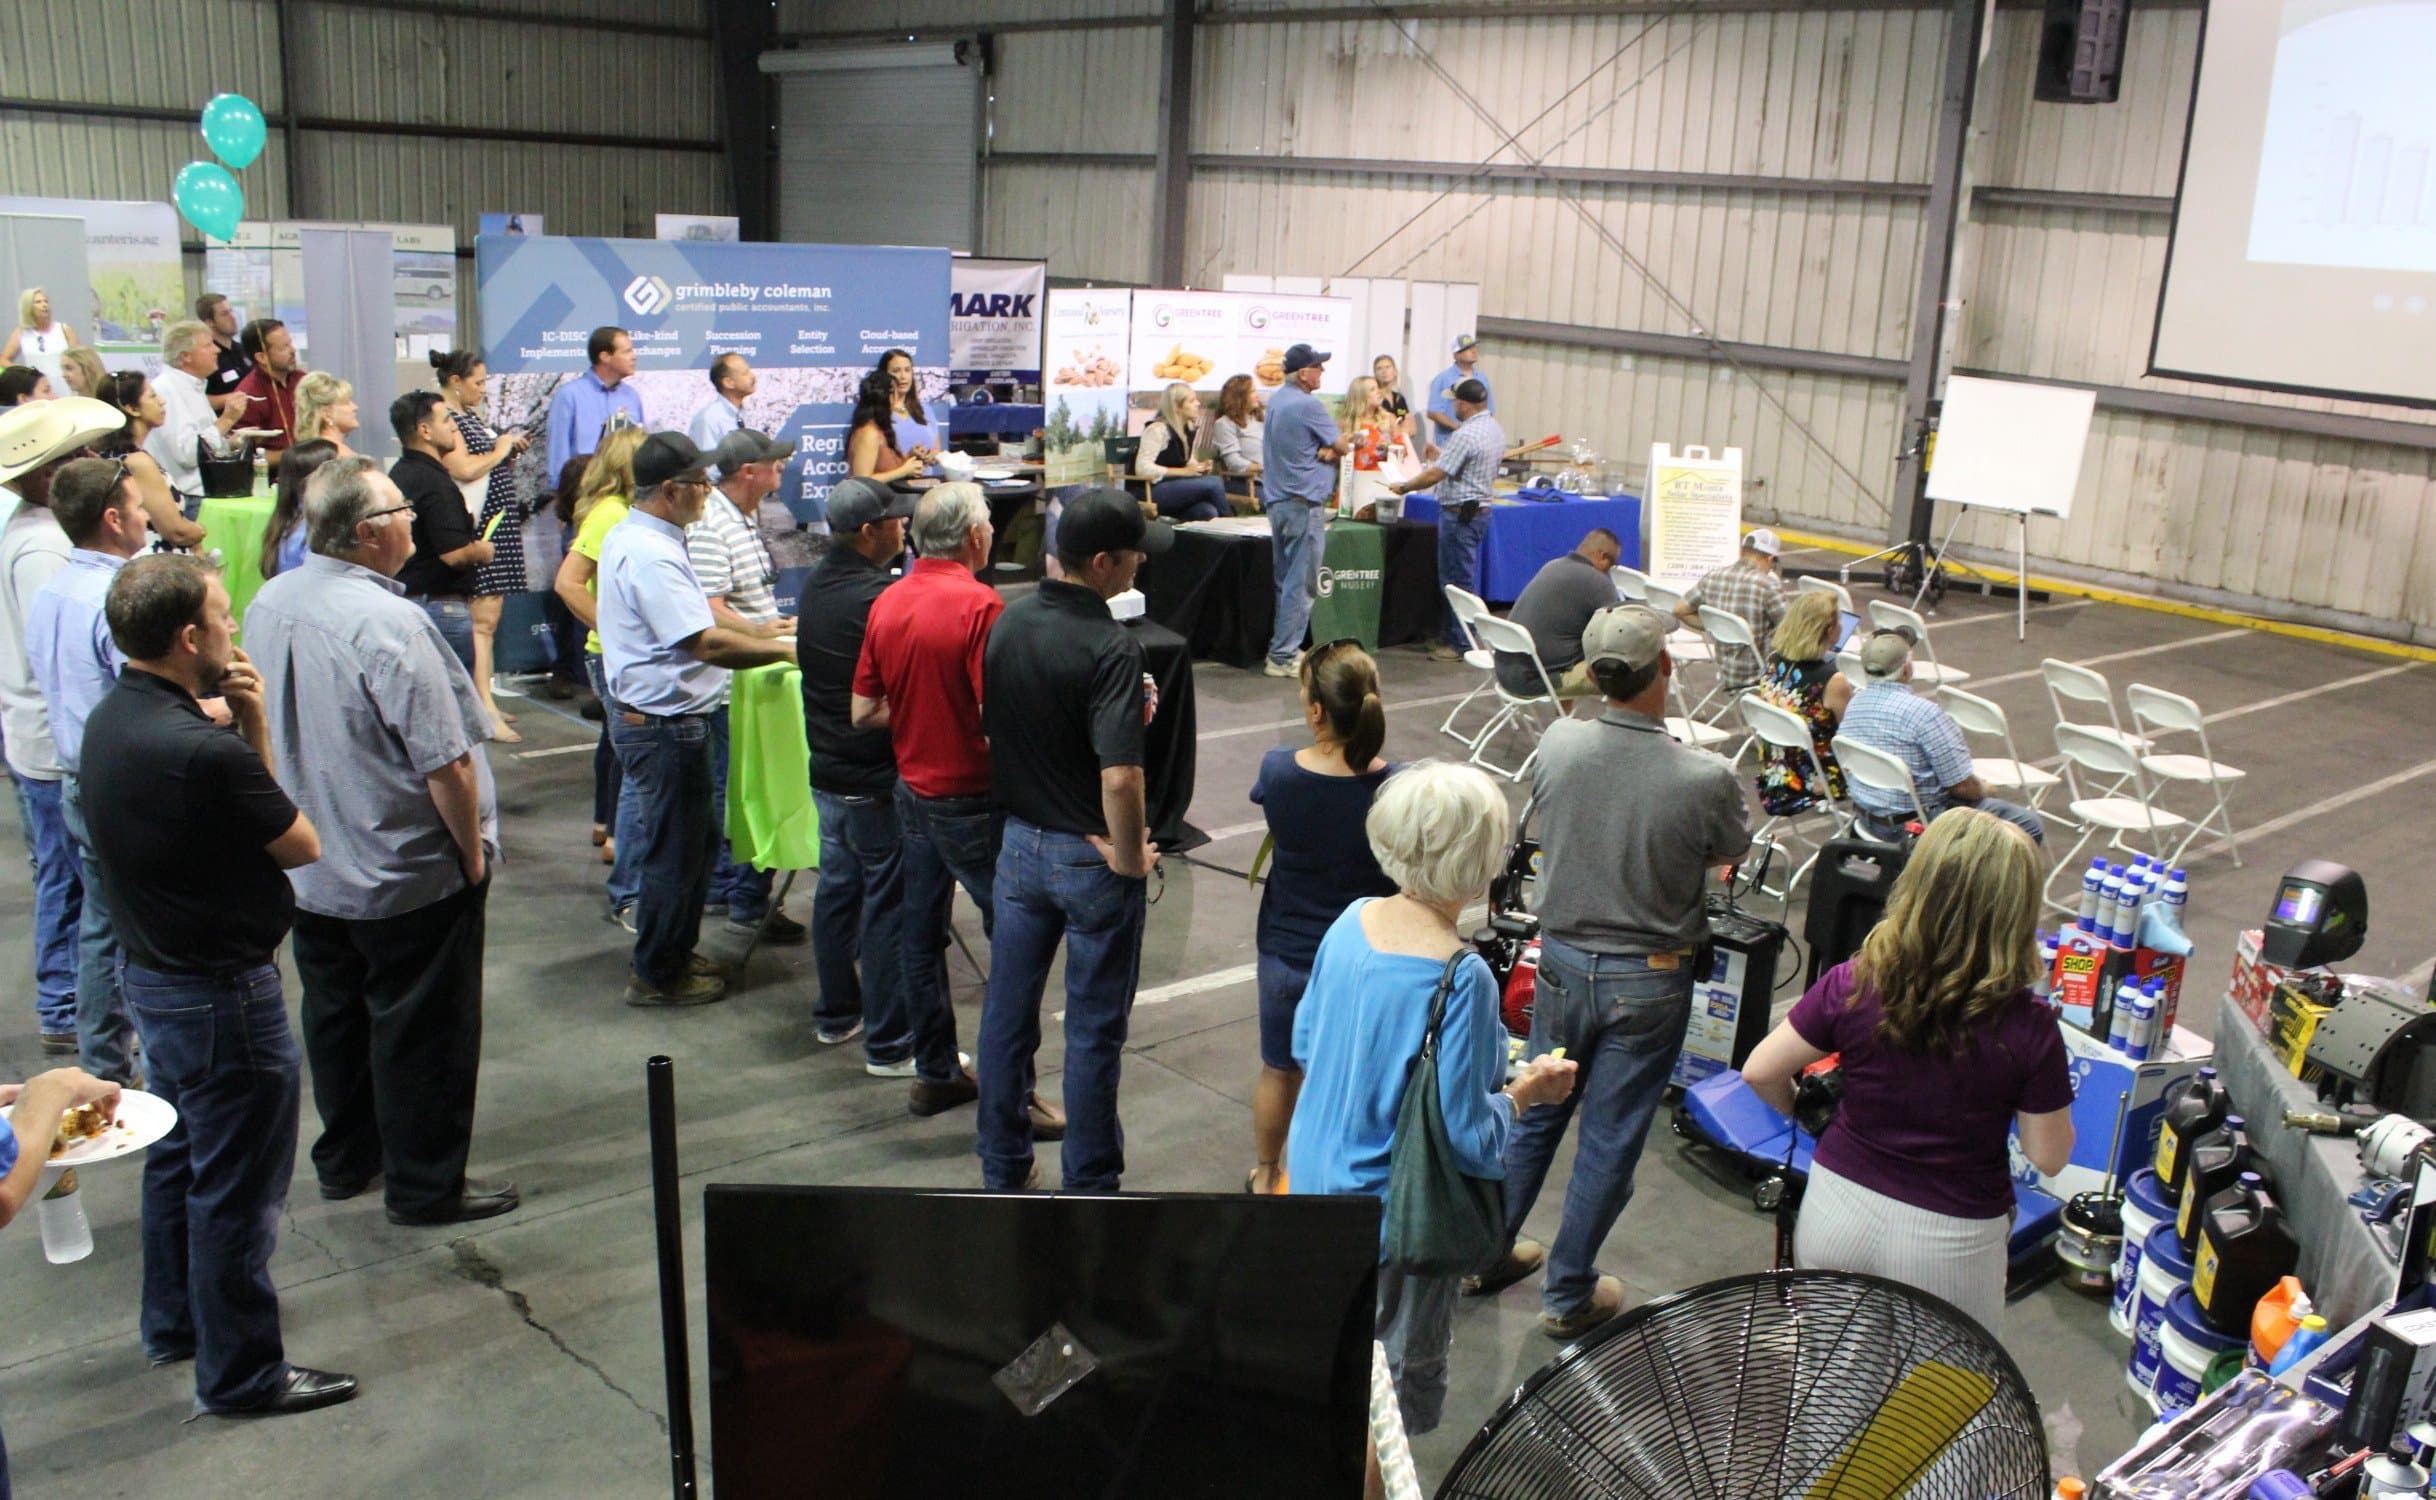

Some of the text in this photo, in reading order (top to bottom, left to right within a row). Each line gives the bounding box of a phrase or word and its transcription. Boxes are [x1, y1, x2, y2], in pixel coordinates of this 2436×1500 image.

[675, 283, 832, 301] grimbleby coleman
[674, 303, 715, 312] certified
[719, 303, 749, 313] public
[1175, 308, 1223, 318] GREENTREE
[1271, 310, 1331, 322] GREENTREE
[542, 330, 588, 342] IC-DISC
[705, 329, 761, 341] Succession
[798, 329, 828, 342] Entity
[860, 330, 919, 341] Cloud-based
[790, 344, 836, 354] Selection
[801, 458, 850, 476] Acco
[2063, 956, 2094, 971] SHOP
